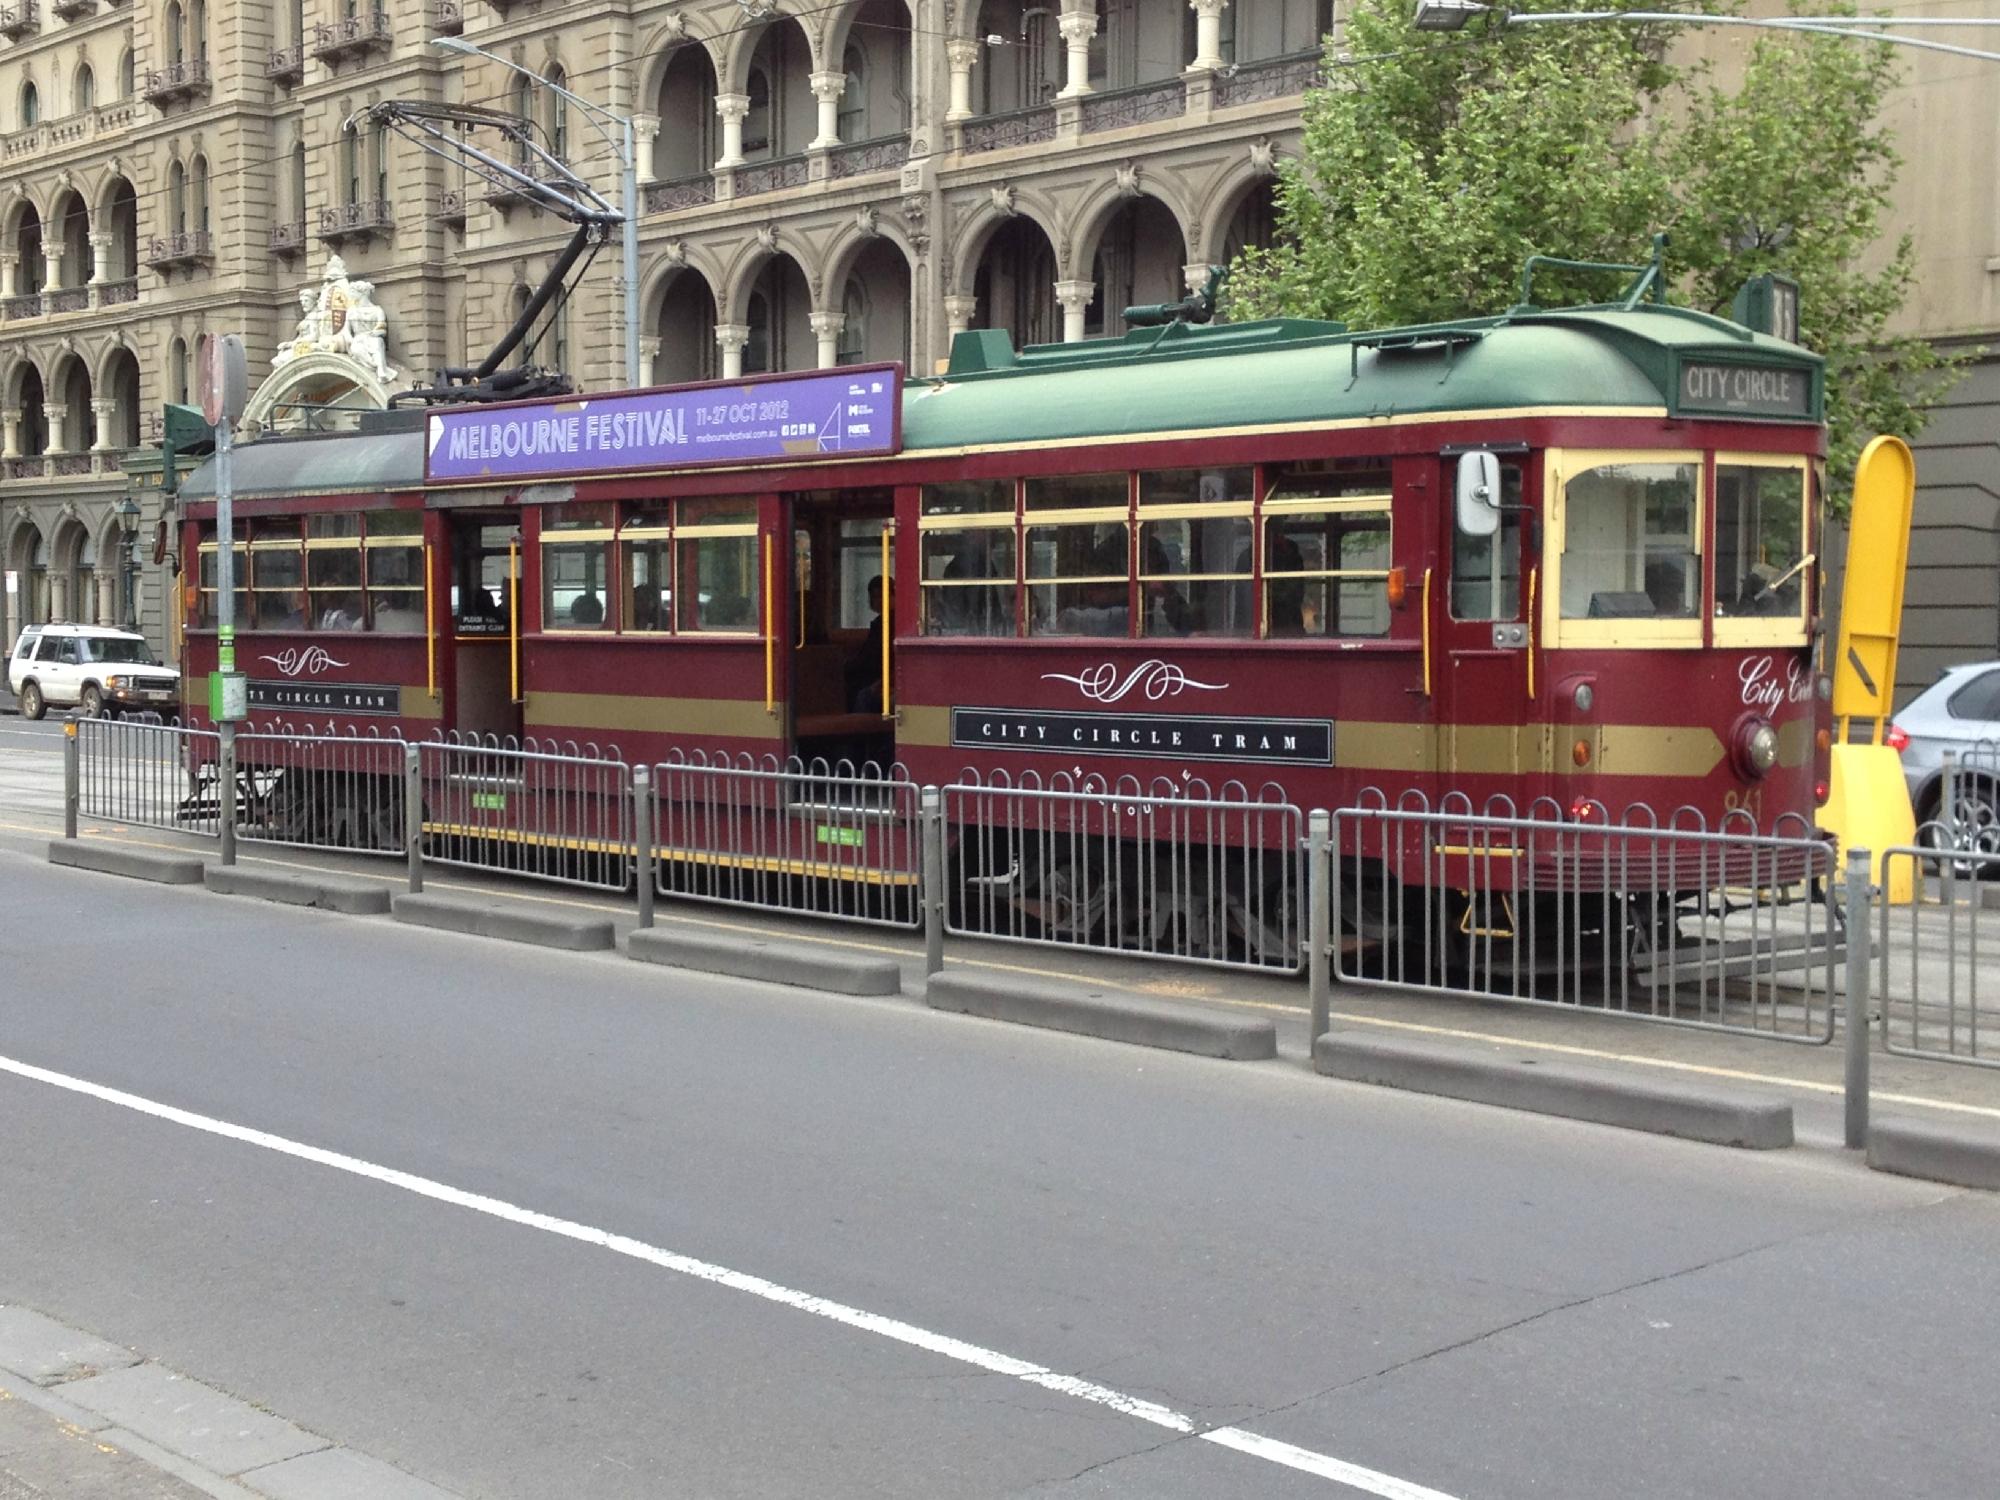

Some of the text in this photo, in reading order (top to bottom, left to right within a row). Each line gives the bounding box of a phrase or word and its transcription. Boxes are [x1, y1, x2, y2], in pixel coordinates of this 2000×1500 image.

[1686, 366, 1790, 402] CITY CIRCLE
[729, 402, 757, 423] OCT
[759, 399, 789, 421] 2012
[448, 408, 689, 460] MELBOURNE FESTIVAL
[276, 691, 331, 704] CIRCLE
[344, 694, 385, 706] TRAM
[1738, 655, 1784, 718] City
[982, 722, 1297, 750] CITY CIRCLE TRAM
